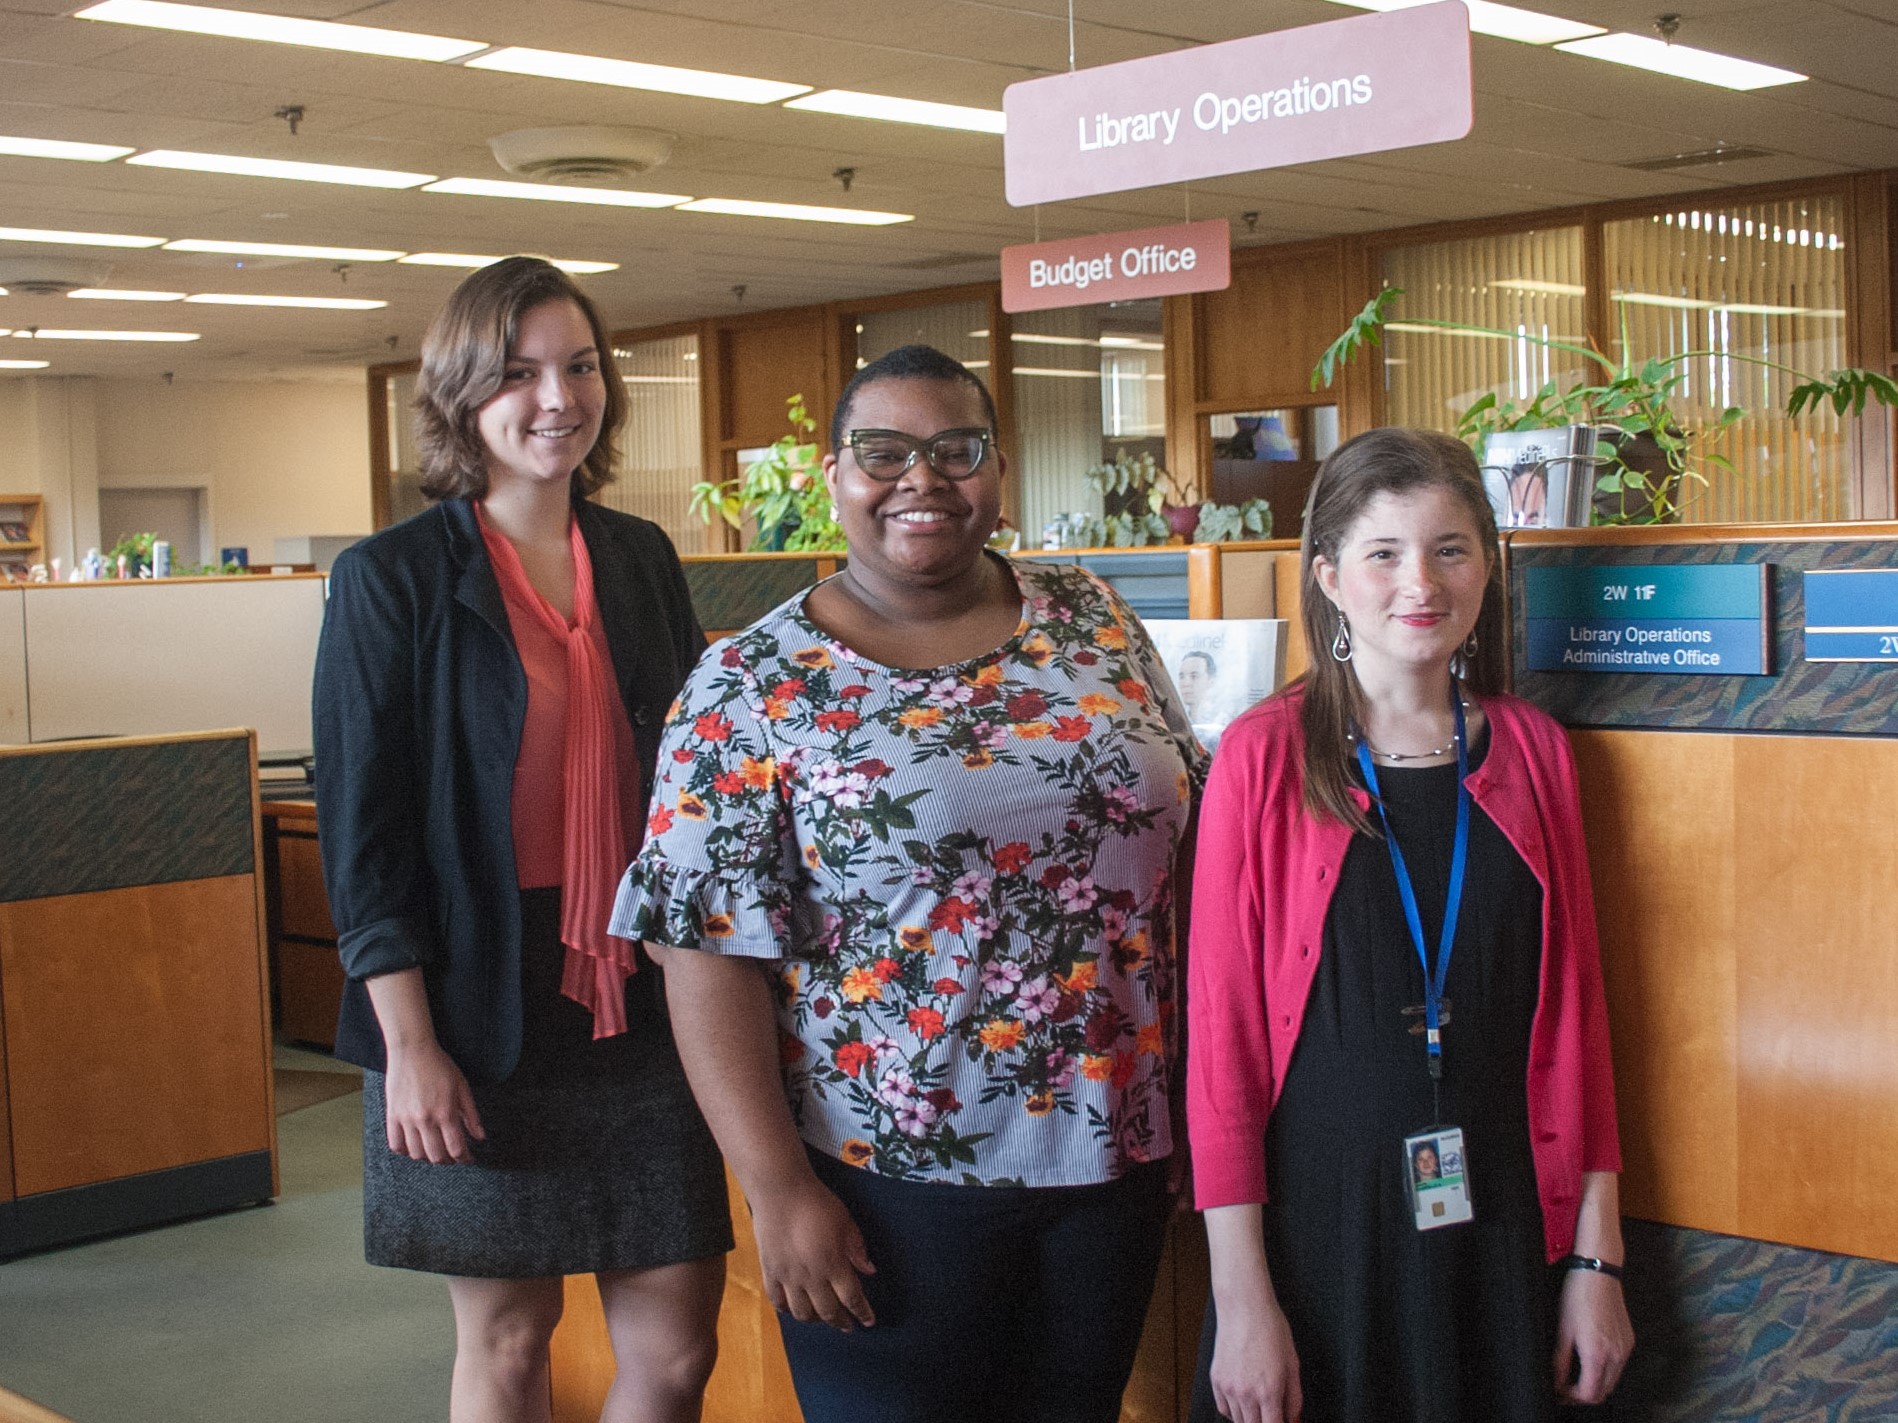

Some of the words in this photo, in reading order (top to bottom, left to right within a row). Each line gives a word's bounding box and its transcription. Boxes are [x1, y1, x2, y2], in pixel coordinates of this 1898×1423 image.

[1079, 106, 1181, 151] Library
[1193, 74, 1373, 134] Operations
[1029, 250, 1113, 289] Budget
[1120, 243, 1197, 279] Office
[1603, 585, 1628, 601] 2W
[1570, 626, 1621, 645] Library
[1625, 626, 1712, 645] Operations
[1563, 648, 1670, 666] Administrative
[1673, 649, 1721, 666] Office
